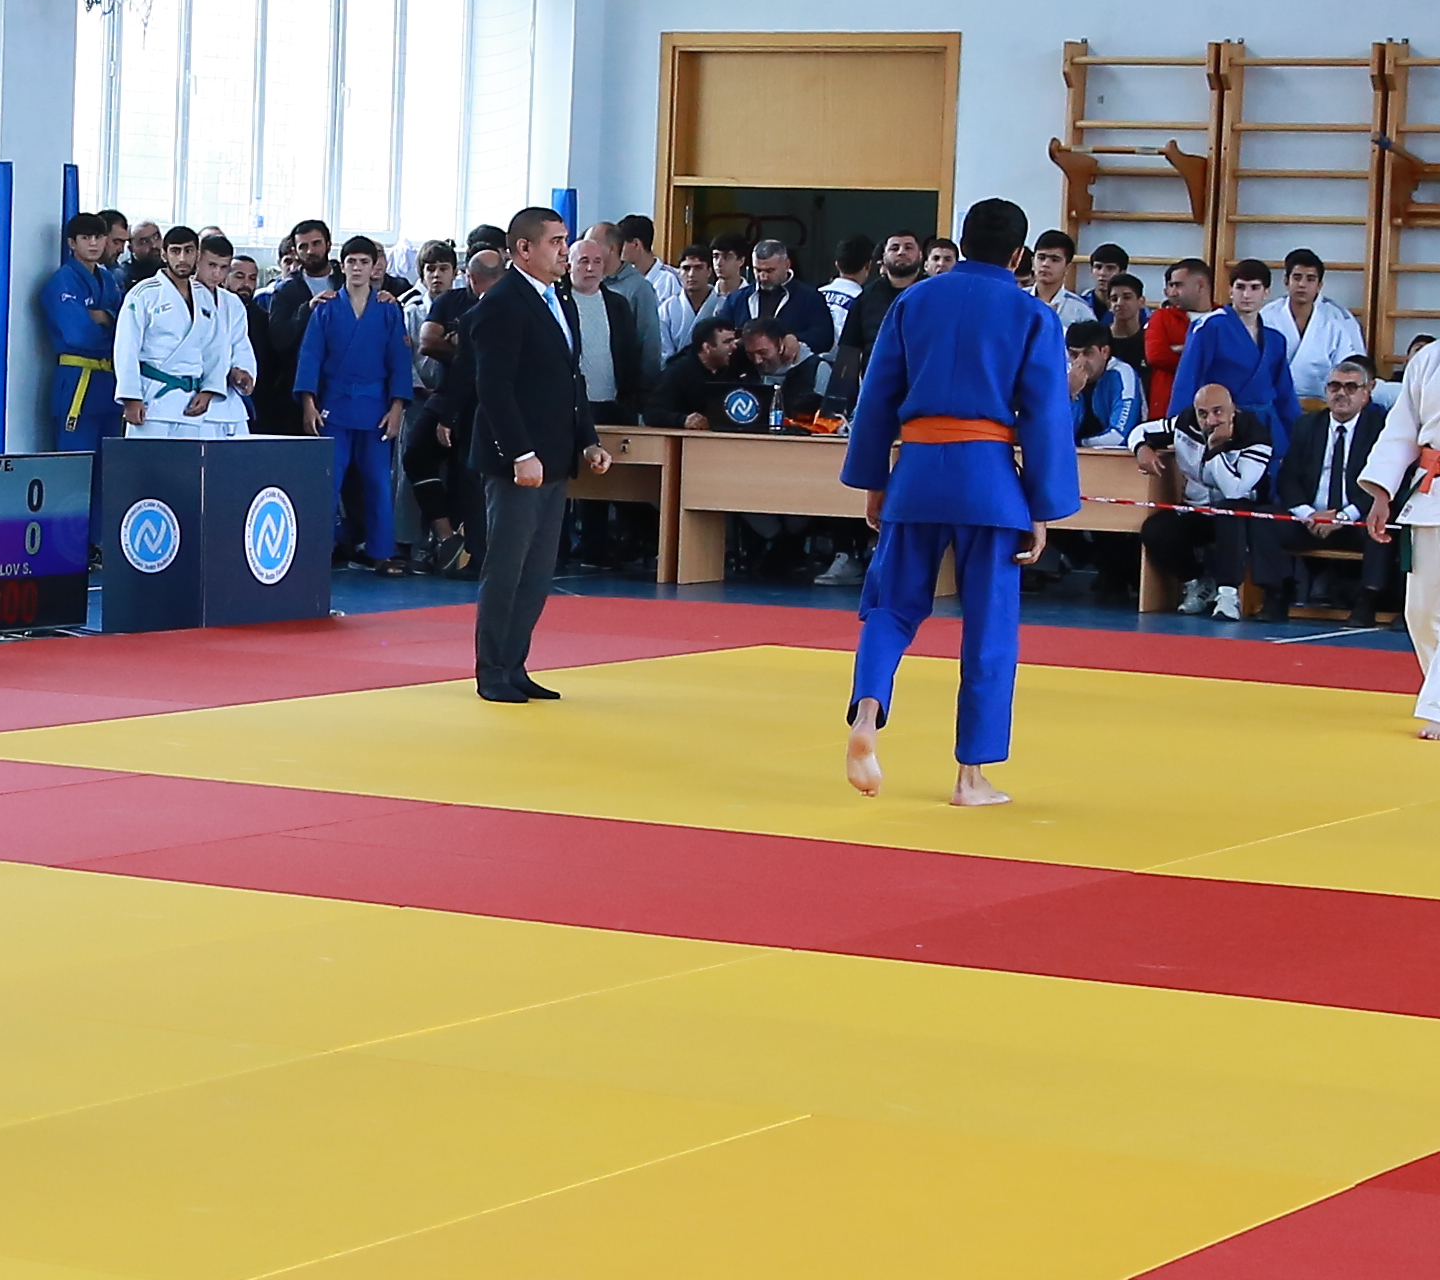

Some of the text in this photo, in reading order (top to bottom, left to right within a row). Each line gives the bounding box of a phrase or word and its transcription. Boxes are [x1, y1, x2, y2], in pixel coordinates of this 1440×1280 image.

[4, 459, 14, 472] E.
[27, 478, 45, 512] 0
[25, 521, 41, 555] 0
[22, 562, 32, 575] S.
